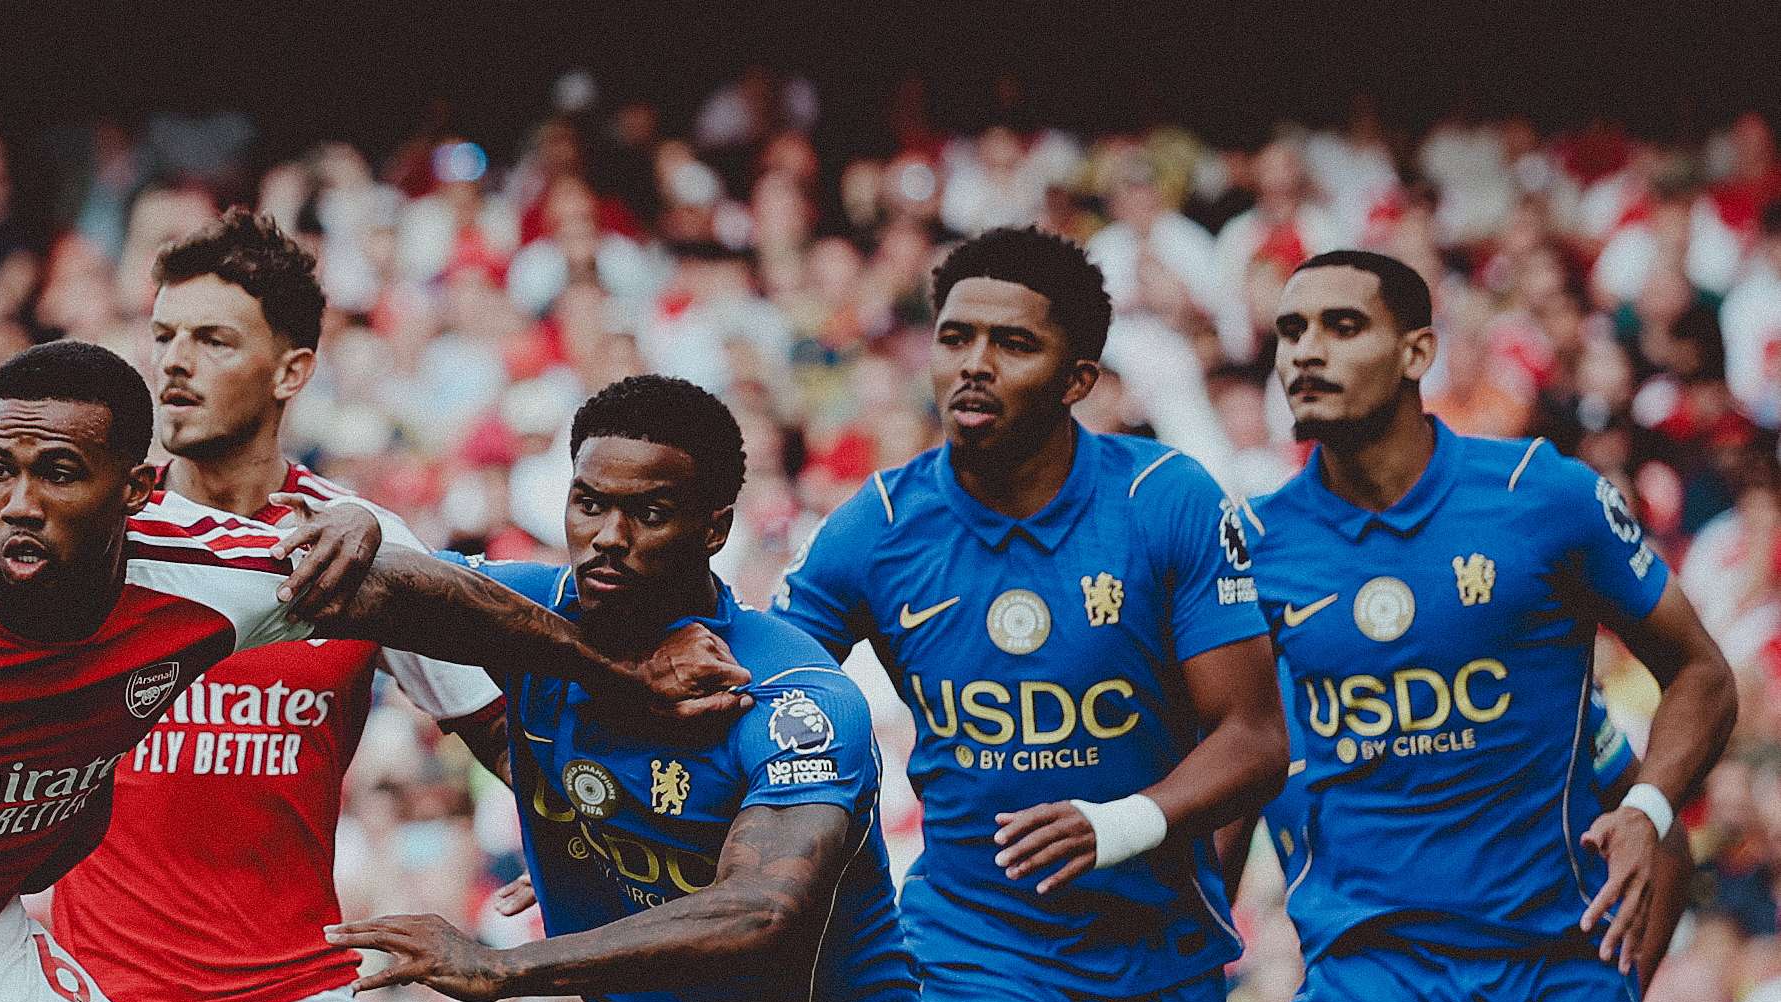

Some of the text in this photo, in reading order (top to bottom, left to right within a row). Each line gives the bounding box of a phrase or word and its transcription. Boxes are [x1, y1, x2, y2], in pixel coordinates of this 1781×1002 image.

[135, 669, 173, 685] Arsenal
[158, 673, 335, 728] irates
[911, 674, 1141, 746] USDC
[1306, 658, 1512, 738] USDC
[193, 731, 302, 776] BETTER
[980, 746, 1100, 771] BY CIRCLE
[1362, 728, 1477, 760] BY CIRCLE
[578, 764, 617, 801] CHAMPIONS
[767, 759, 833, 775] No room
[581, 803, 604, 816] FIFA
